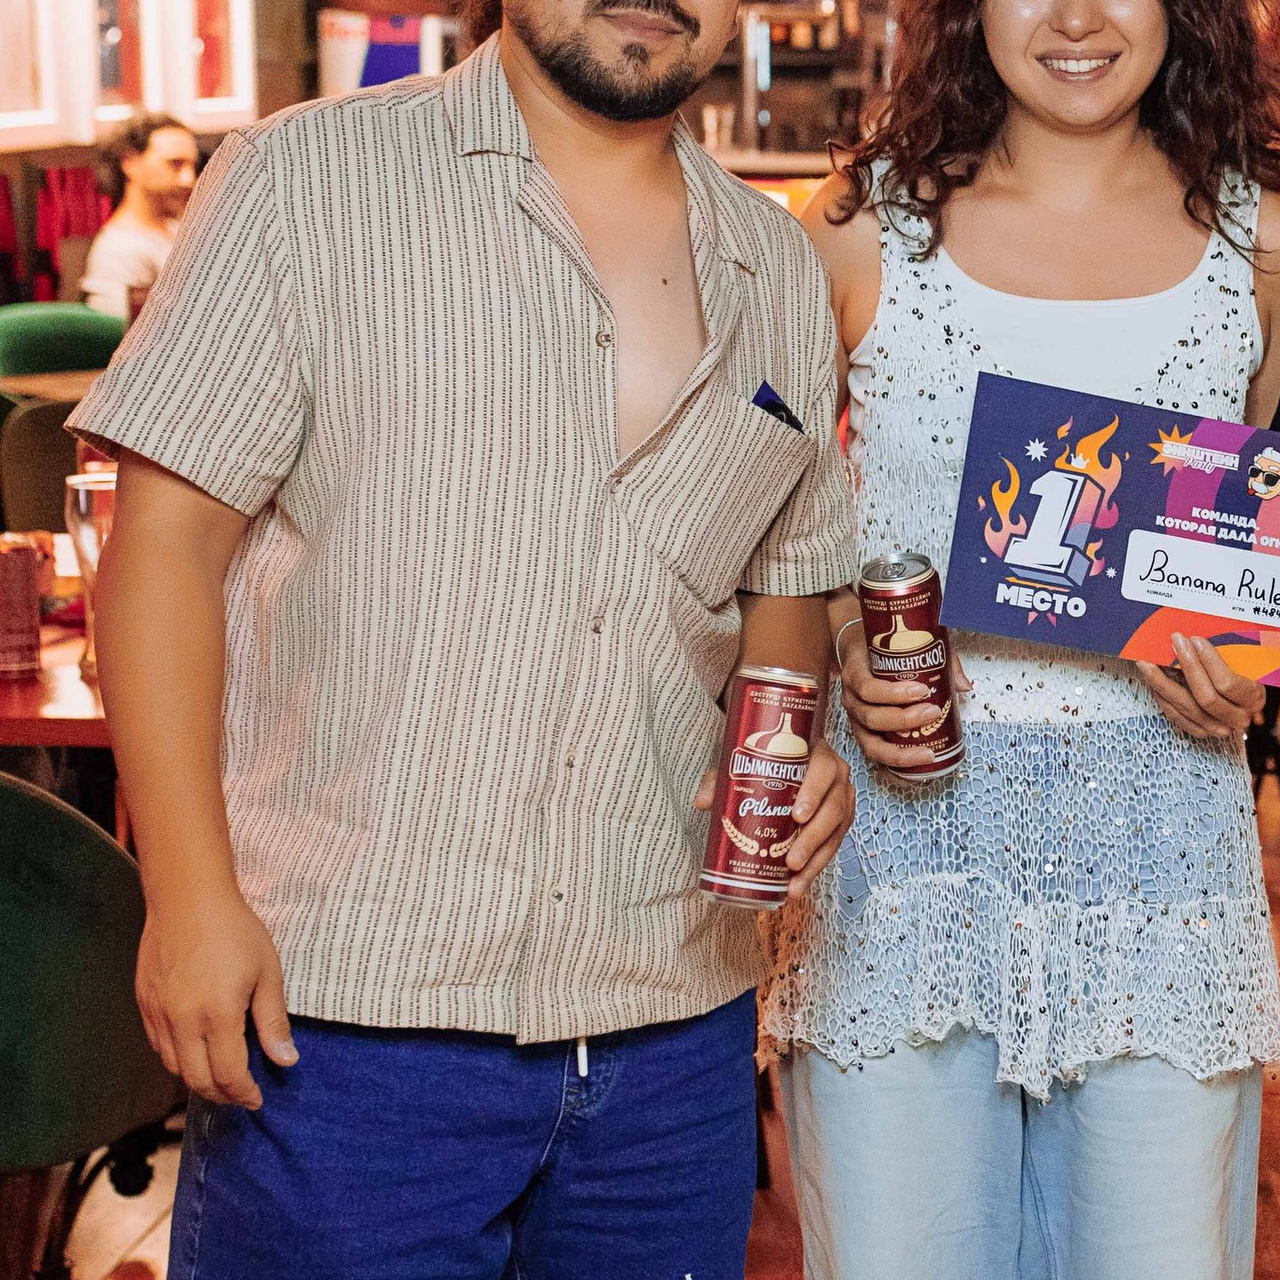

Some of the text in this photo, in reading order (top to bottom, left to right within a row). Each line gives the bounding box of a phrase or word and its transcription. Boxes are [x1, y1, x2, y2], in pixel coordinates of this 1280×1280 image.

[1004, 469, 1092, 578] 1
[1155, 515, 1217, 537] КОТОРАЯ
[1217, 528, 1258, 545] ДАЛА
[1192, 507, 1261, 531] КОМАНДА,
[1139, 549, 1226, 596] Banana
[995, 583, 1087, 618] МЕСТО
[1146, 589, 1174, 599] КОМАНДА
[870, 645, 944, 671] ШЫМКЕНТСКОЕ
[732, 753, 809, 782] ШЫМКЕНТСКО
[767, 781, 783, 789] 1976
[739, 796, 795, 817] Pilsner
[754, 826, 778, 839] 4,0%
